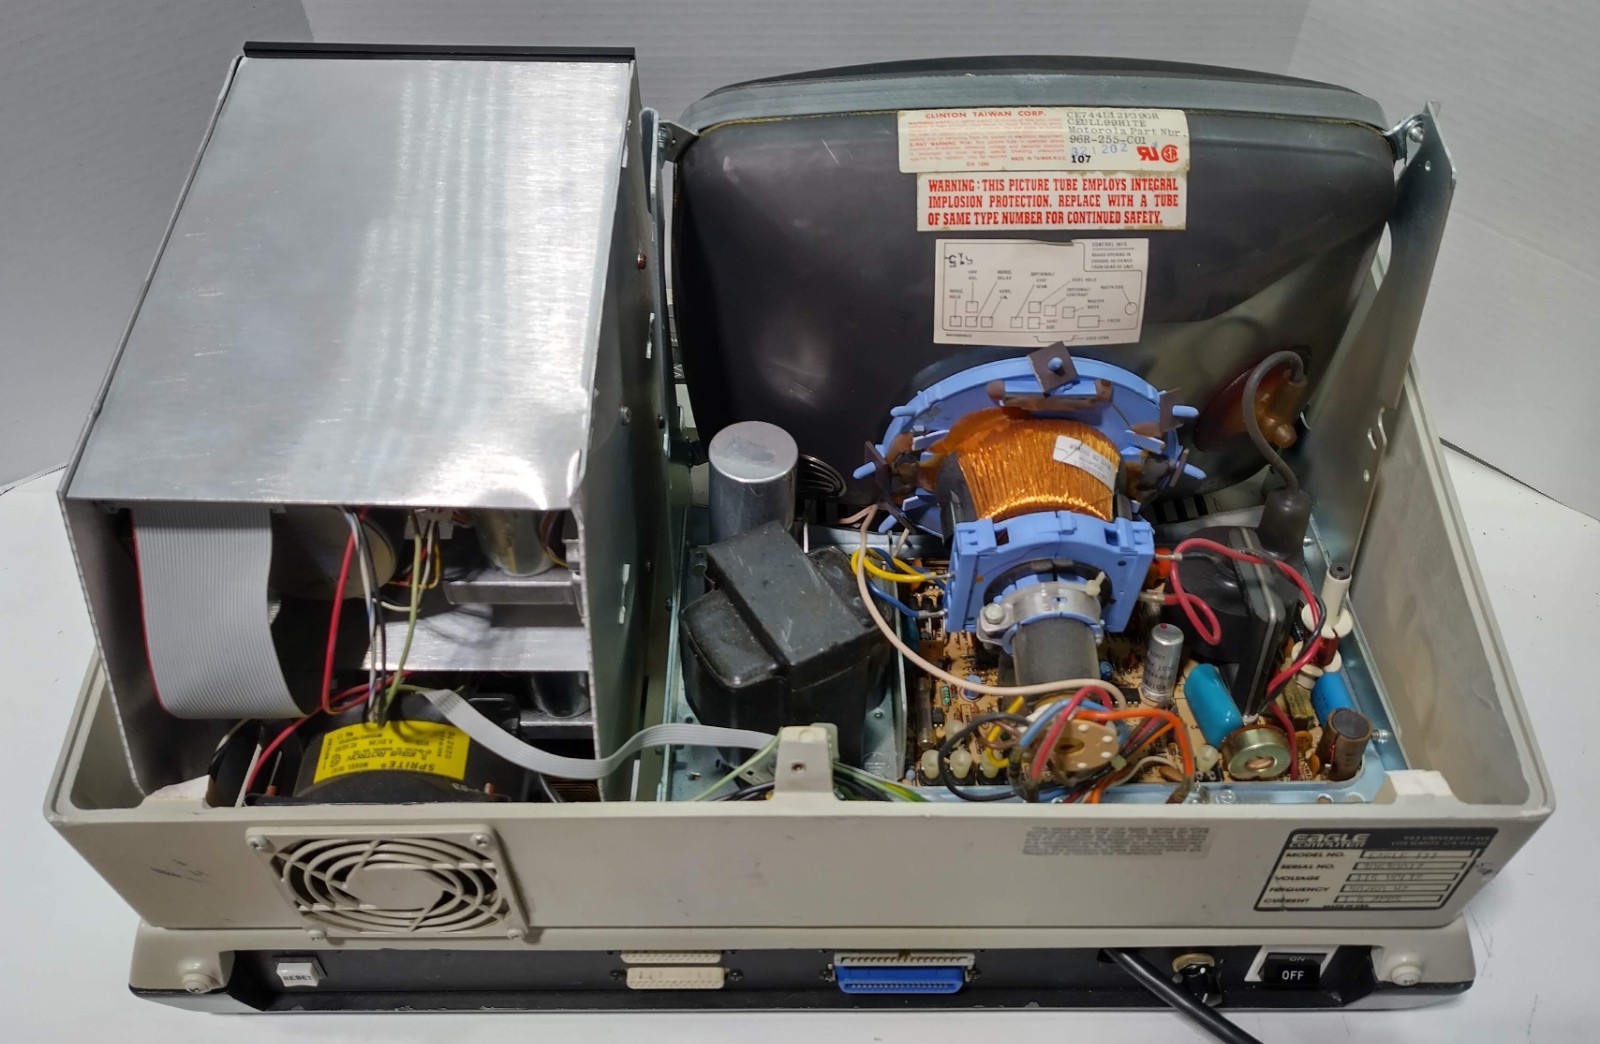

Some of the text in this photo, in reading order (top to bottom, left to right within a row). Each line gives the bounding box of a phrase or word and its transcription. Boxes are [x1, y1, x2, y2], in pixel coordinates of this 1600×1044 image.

[1068, 126, 1127, 135] Motorola
[1130, 128, 1157, 136] Part
[1160, 128, 1186, 137] Nbr.
[1070, 135, 1146, 144] 96R-255-C01
[1071, 155, 1091, 163] 107
[982, 179, 1004, 191] THIS
[1009, 179, 1049, 191] PICTURE
[1053, 178, 1078, 191] TUBE
[1082, 178, 1126, 191] EMPLOYS
[1131, 178, 1178, 191] INTEGRAL
[928, 194, 1178, 208] IMPLOSION PROTECTION. REPLACE WITH A TUBE
[928, 211, 1162, 225] OF SAME TYPE NUMBER FOR CONTINUED SAFETY.
[1282, 970, 1304, 980] OFF
